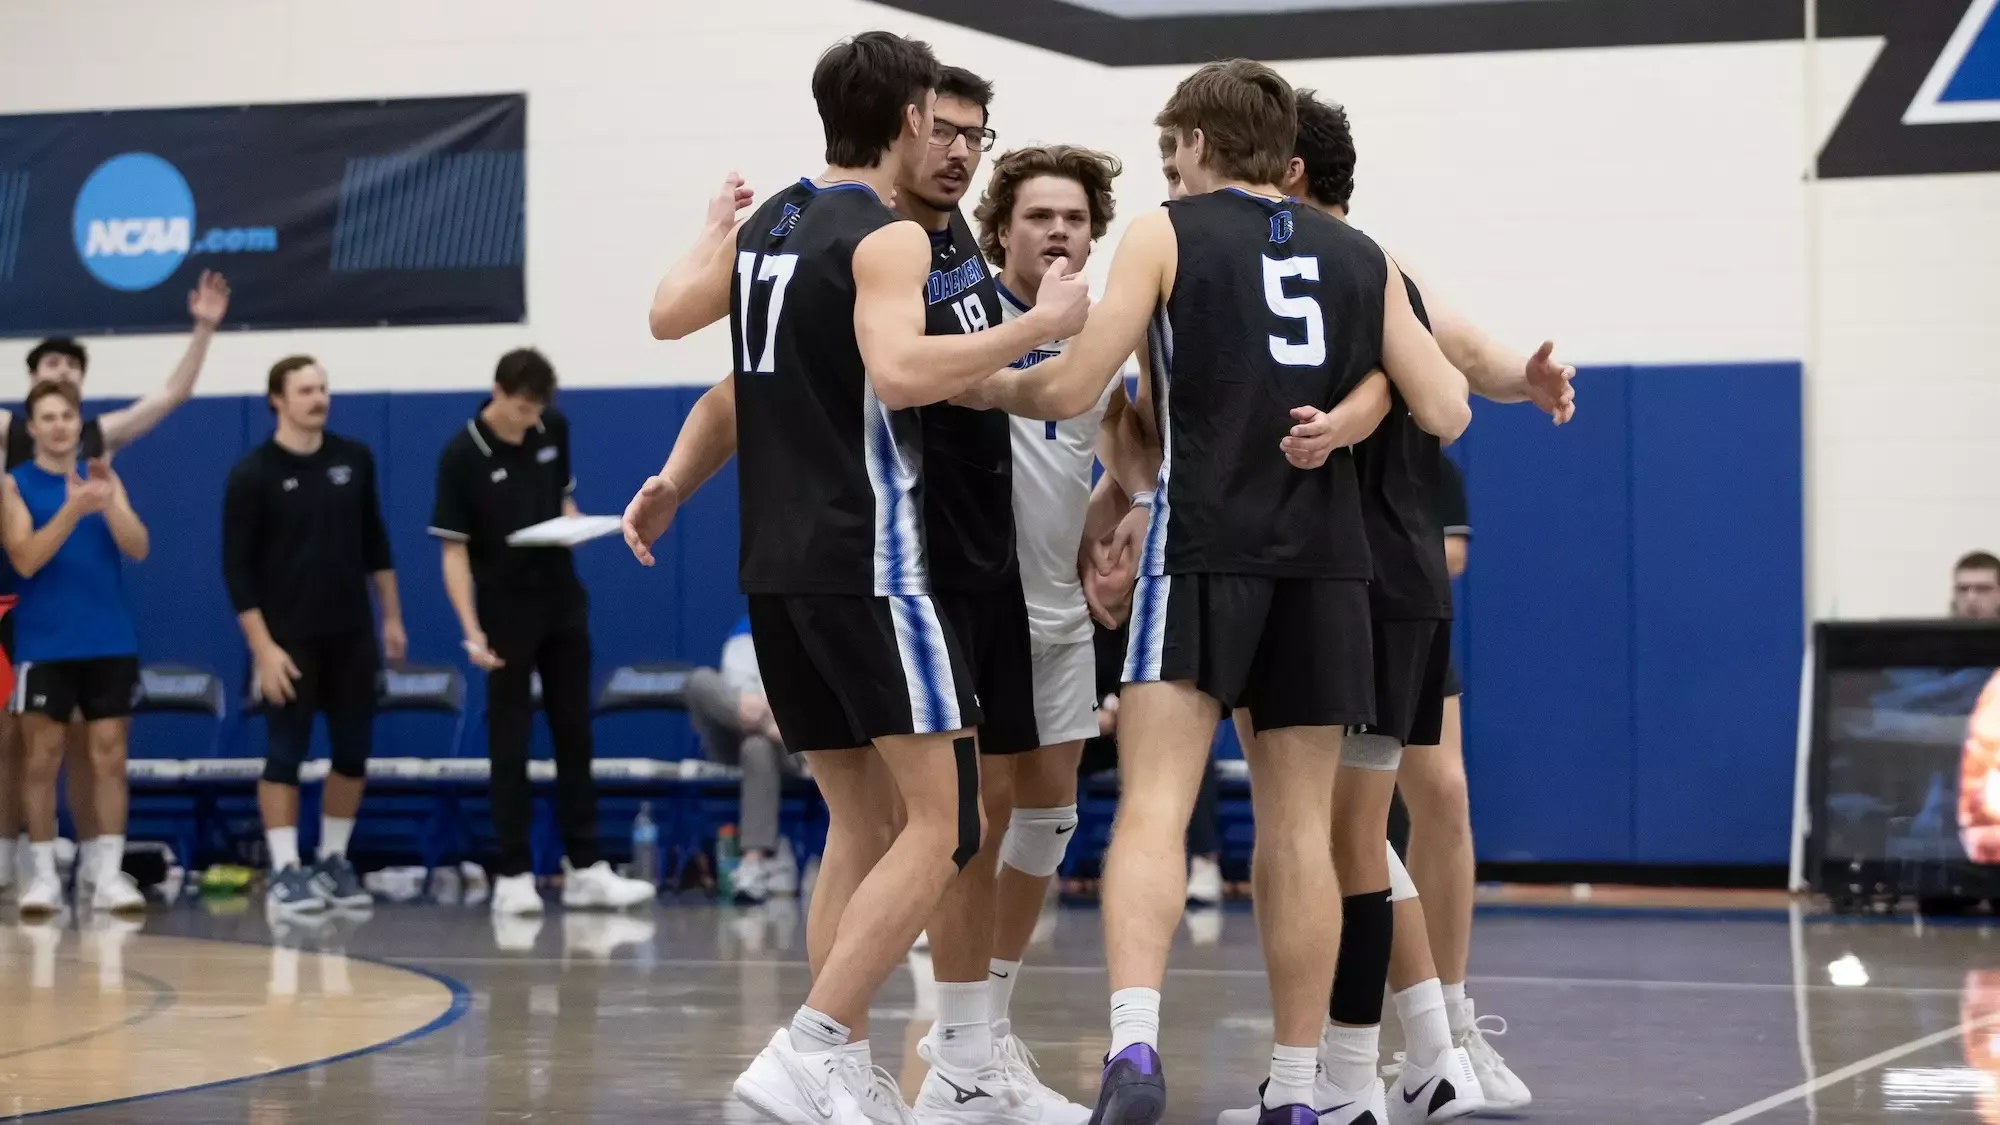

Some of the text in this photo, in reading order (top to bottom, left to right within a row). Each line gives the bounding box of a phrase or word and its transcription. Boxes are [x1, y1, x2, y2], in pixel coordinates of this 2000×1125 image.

[737, 251, 799, 373] 17
[927, 255, 985, 305] DAEMEN
[1261, 253, 1327, 367] 5
